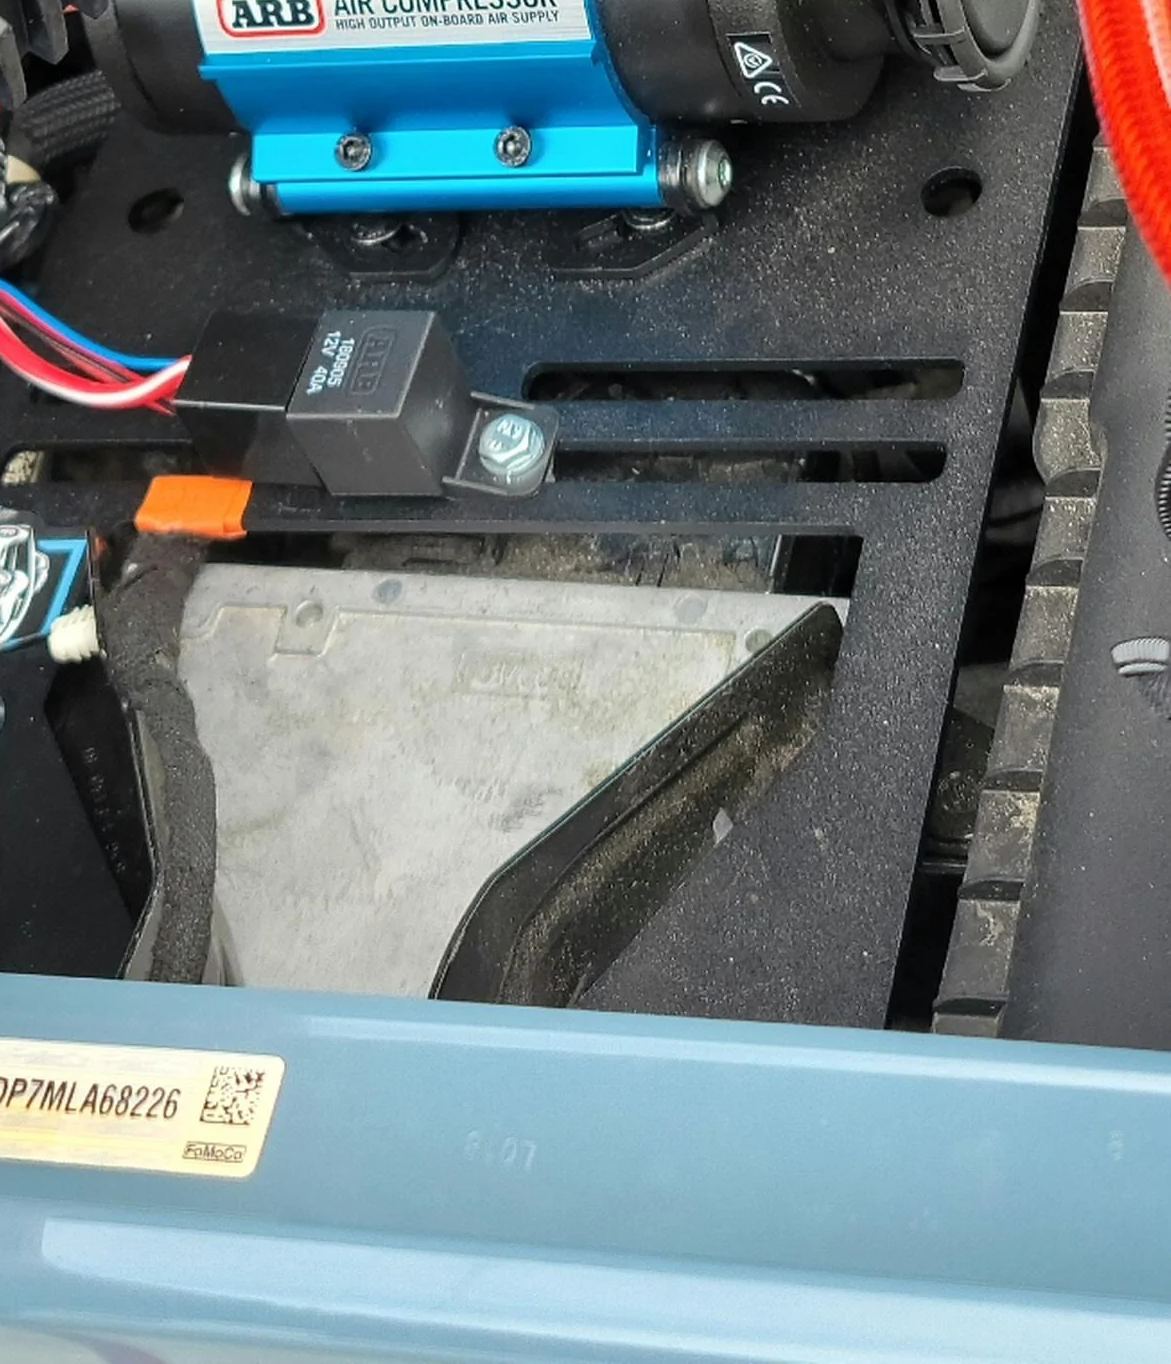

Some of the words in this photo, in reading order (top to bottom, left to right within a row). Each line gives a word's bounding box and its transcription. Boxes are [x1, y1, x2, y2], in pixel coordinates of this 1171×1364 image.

[335, 17, 366, 30] HIGH
[370, 15, 416, 29] OUTPUT
[422, 13, 484, 27] ON-BOARD
[488, 12, 508, 25] AIR
[512, 10, 560, 24] SUPPLY
[321, 330, 341, 357] 12V
[306, 366, 328, 395] 40A
[185, 1145, 243, 1161] FoMoCo
